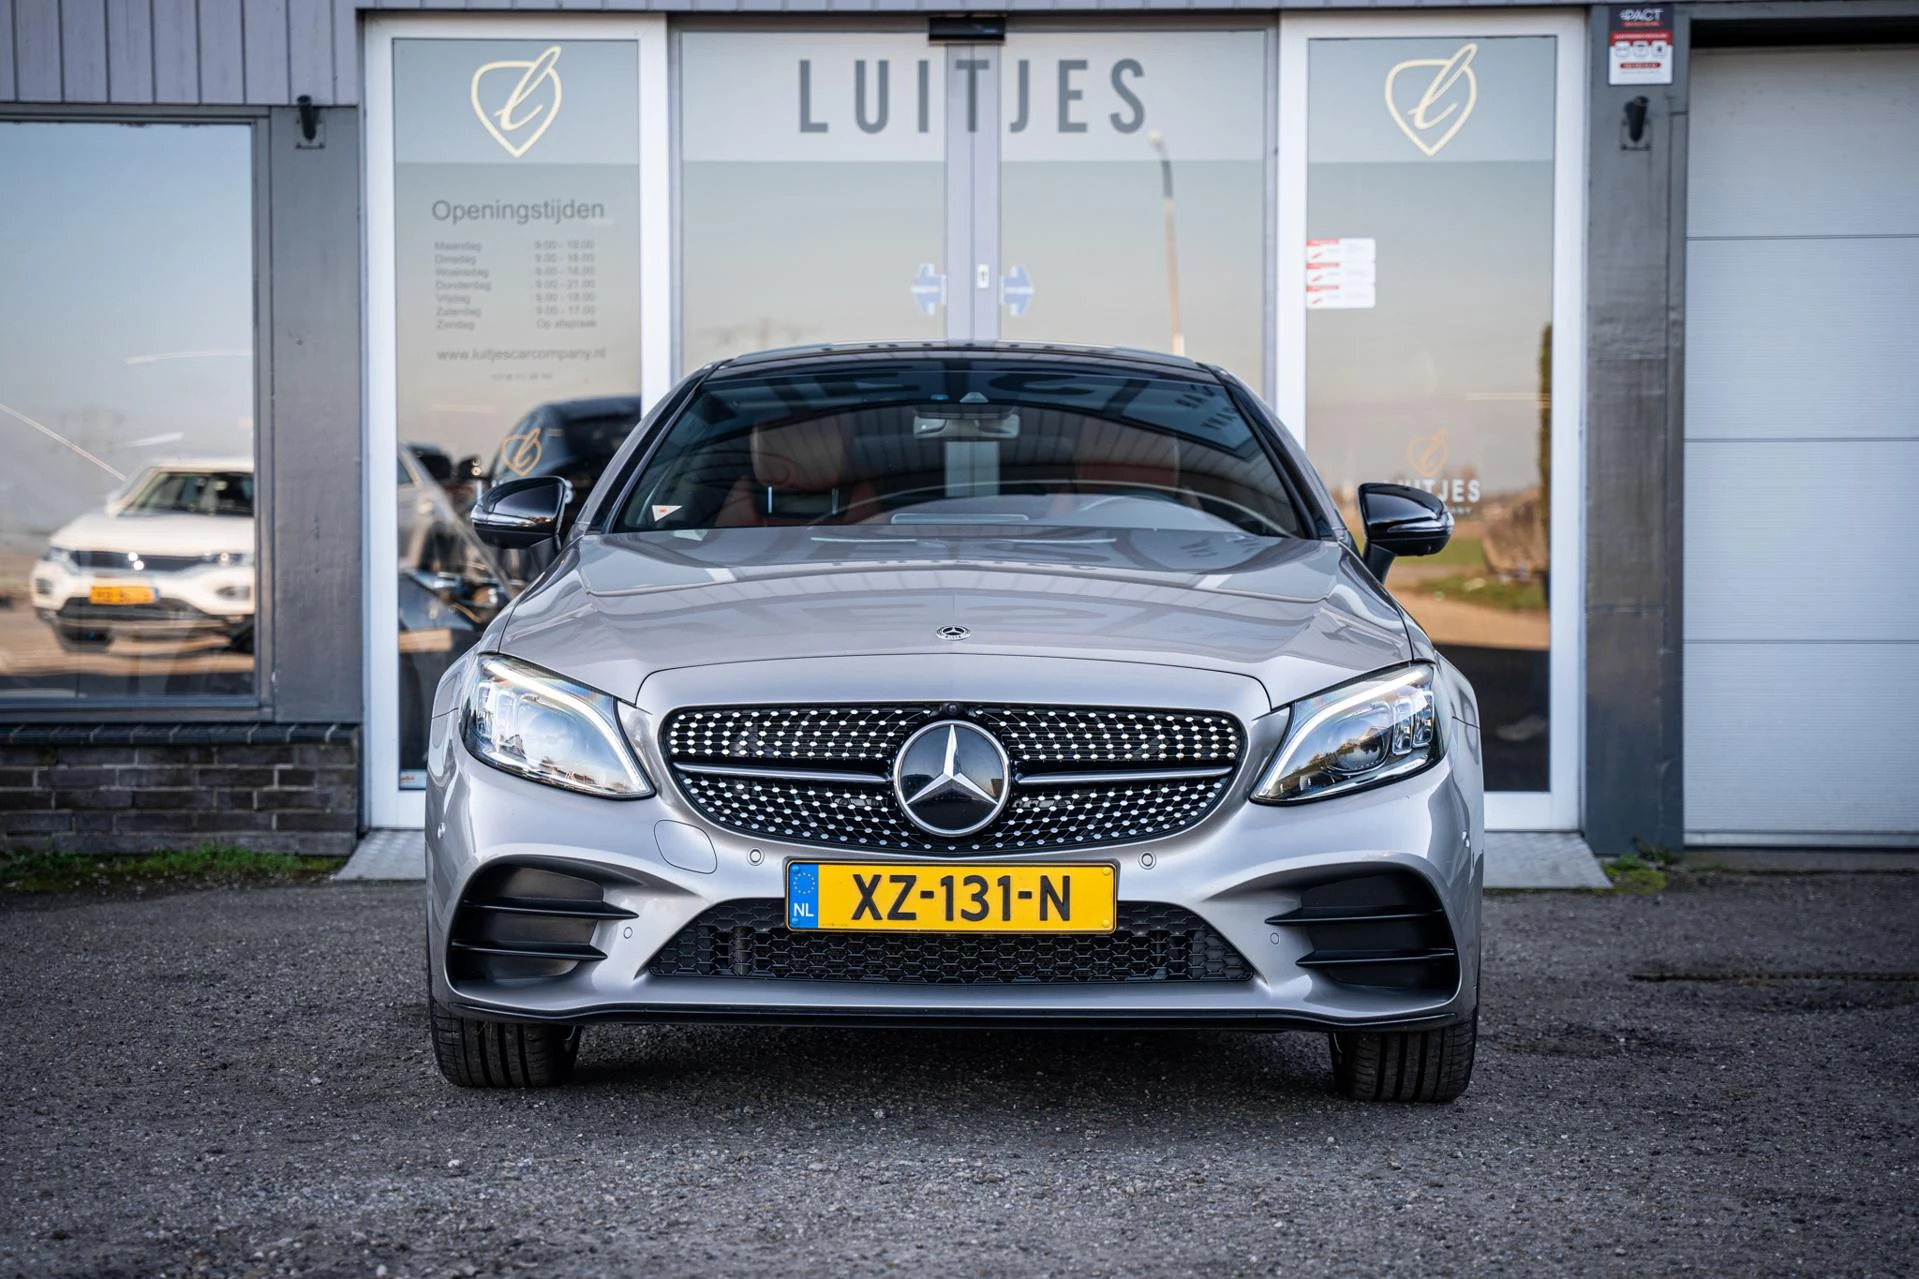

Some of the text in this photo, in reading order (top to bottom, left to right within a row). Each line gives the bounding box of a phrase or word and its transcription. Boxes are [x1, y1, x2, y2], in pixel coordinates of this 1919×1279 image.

[799, 58, 1145, 134] LUITJES
[432, 198, 605, 225] Openingstijden
[436, 347, 607, 363] www.luitjescarcompany.nl
[794, 903, 814, 917] NL
[852, 874, 1070, 922] XZ-131-N
